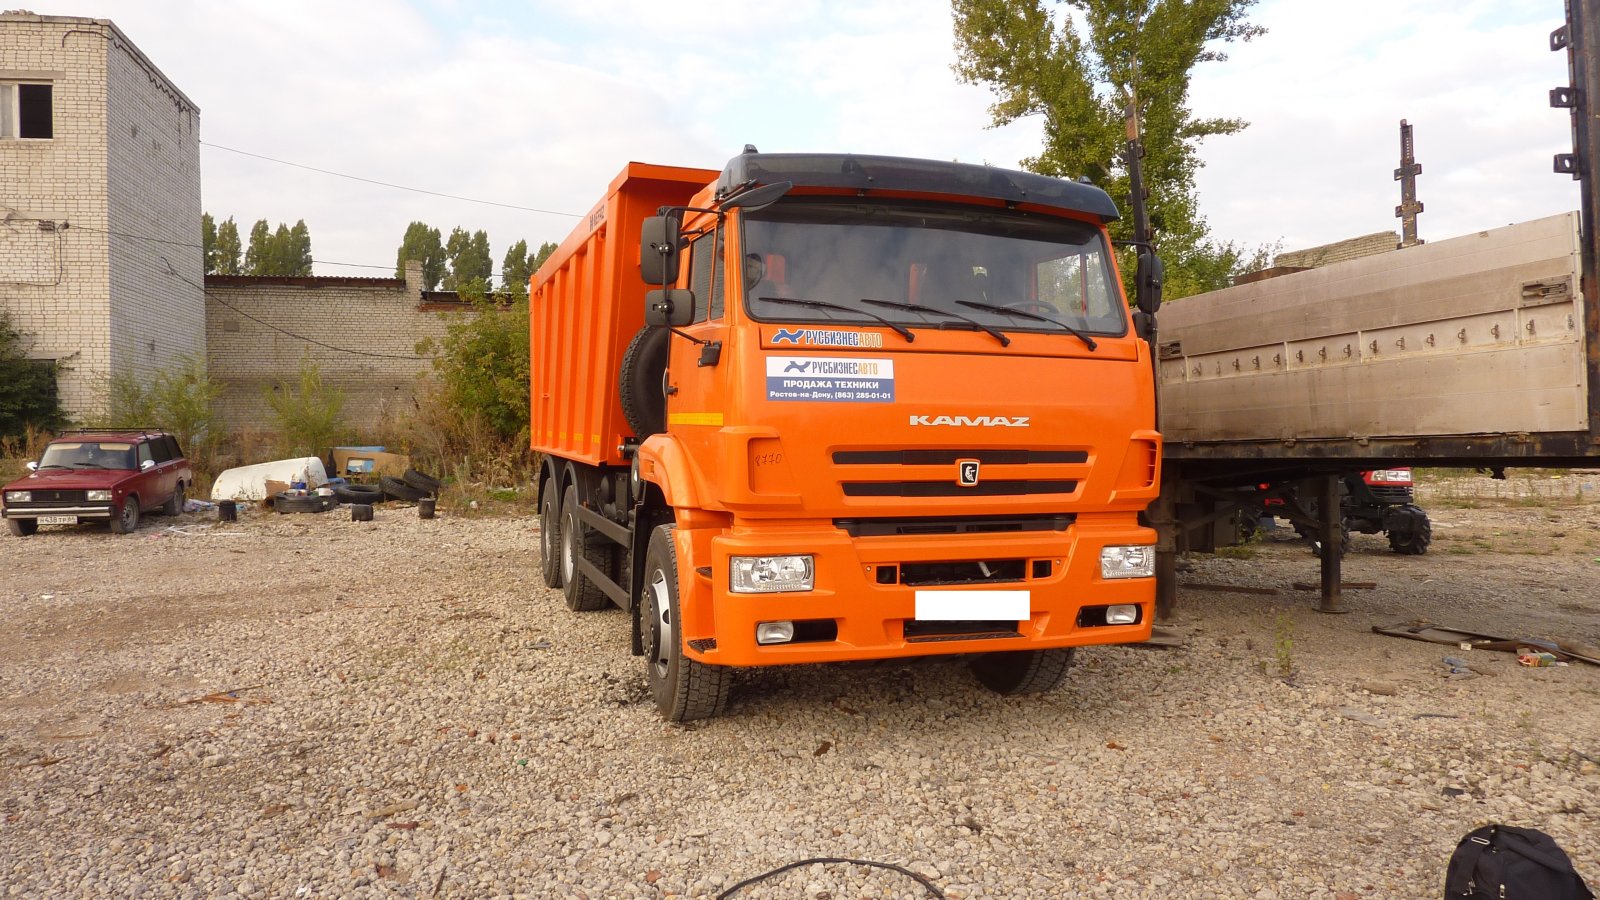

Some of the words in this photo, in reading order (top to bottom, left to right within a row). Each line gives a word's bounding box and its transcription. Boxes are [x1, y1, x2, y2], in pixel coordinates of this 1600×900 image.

[805, 330, 882, 348] РУСБИЗНЕСАВТО
[812, 361, 878, 375] РУСБИЗНЕСАВТО
[783, 380, 832, 389] ПРОДАЖА
[834, 381, 879, 389] ТЕХНИКИ
[834, 391, 854, 400] (863)
[909, 415, 1030, 427] KAMAZ
